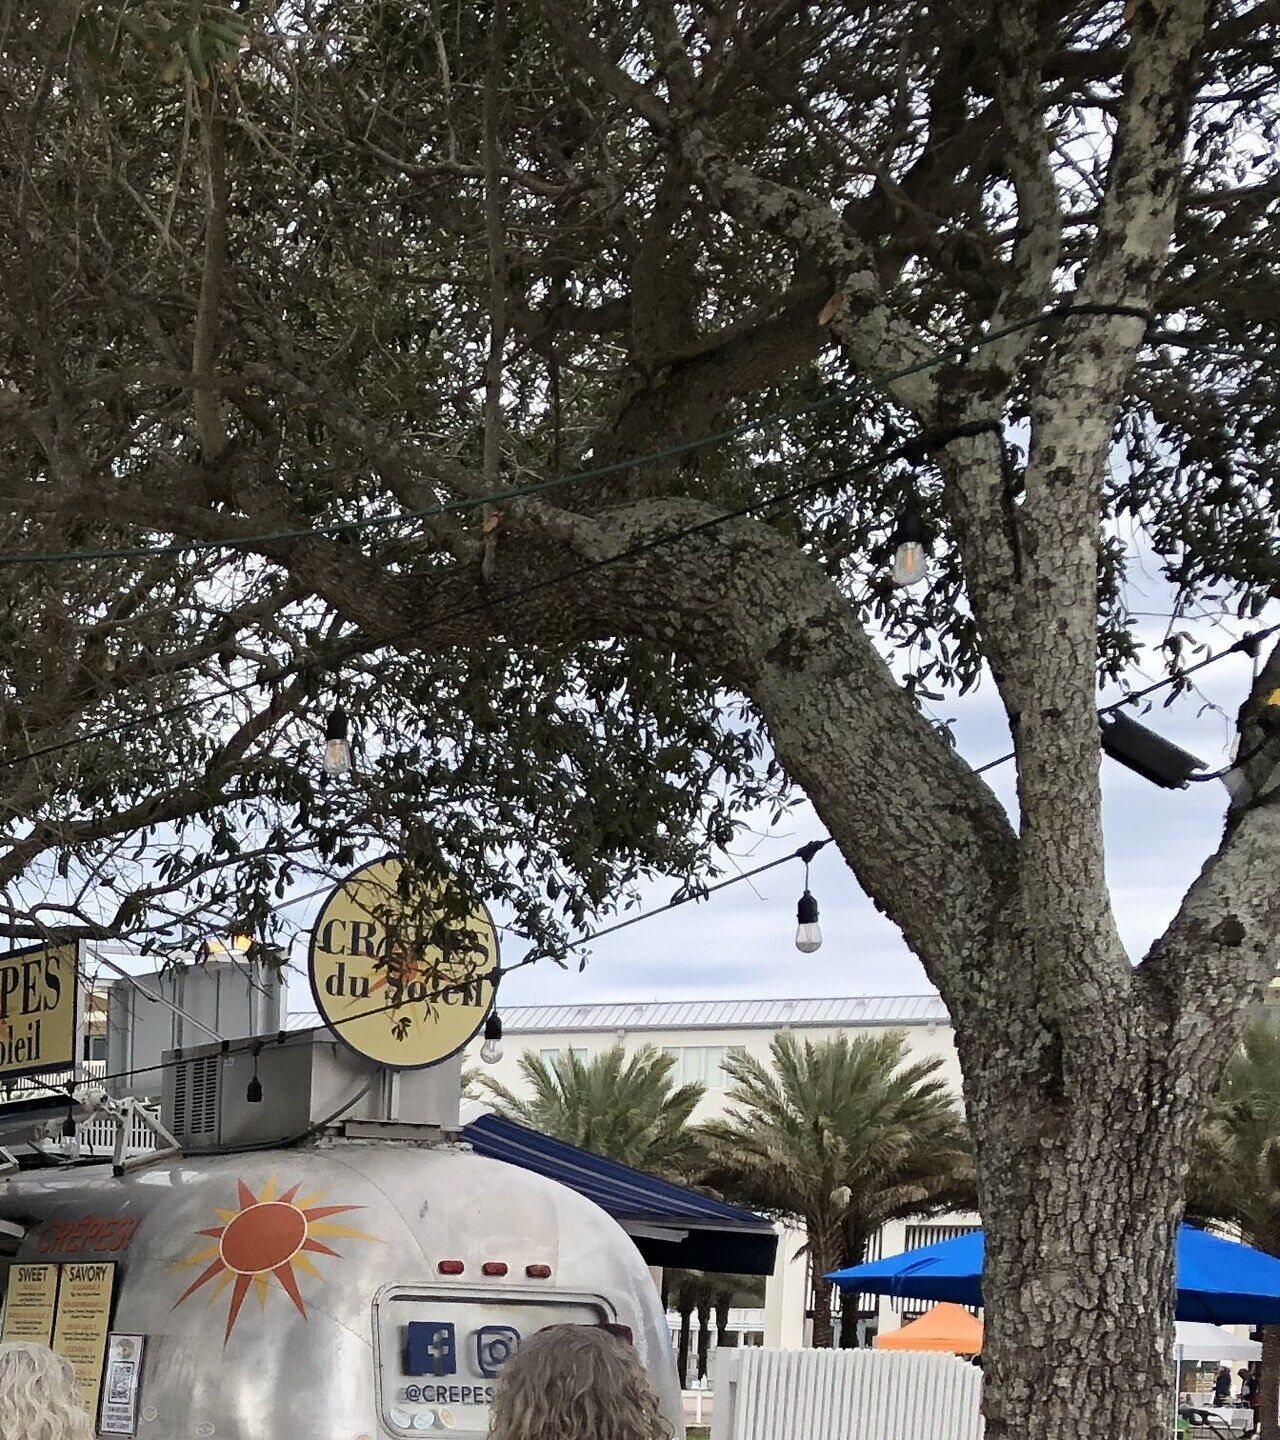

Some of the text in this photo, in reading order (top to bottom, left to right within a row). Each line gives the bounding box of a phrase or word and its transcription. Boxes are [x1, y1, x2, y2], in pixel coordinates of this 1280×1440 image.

[325, 962, 371, 998] du
[18, 1266, 49, 1282] SWEET
[68, 1265, 109, 1282] SAVORY
